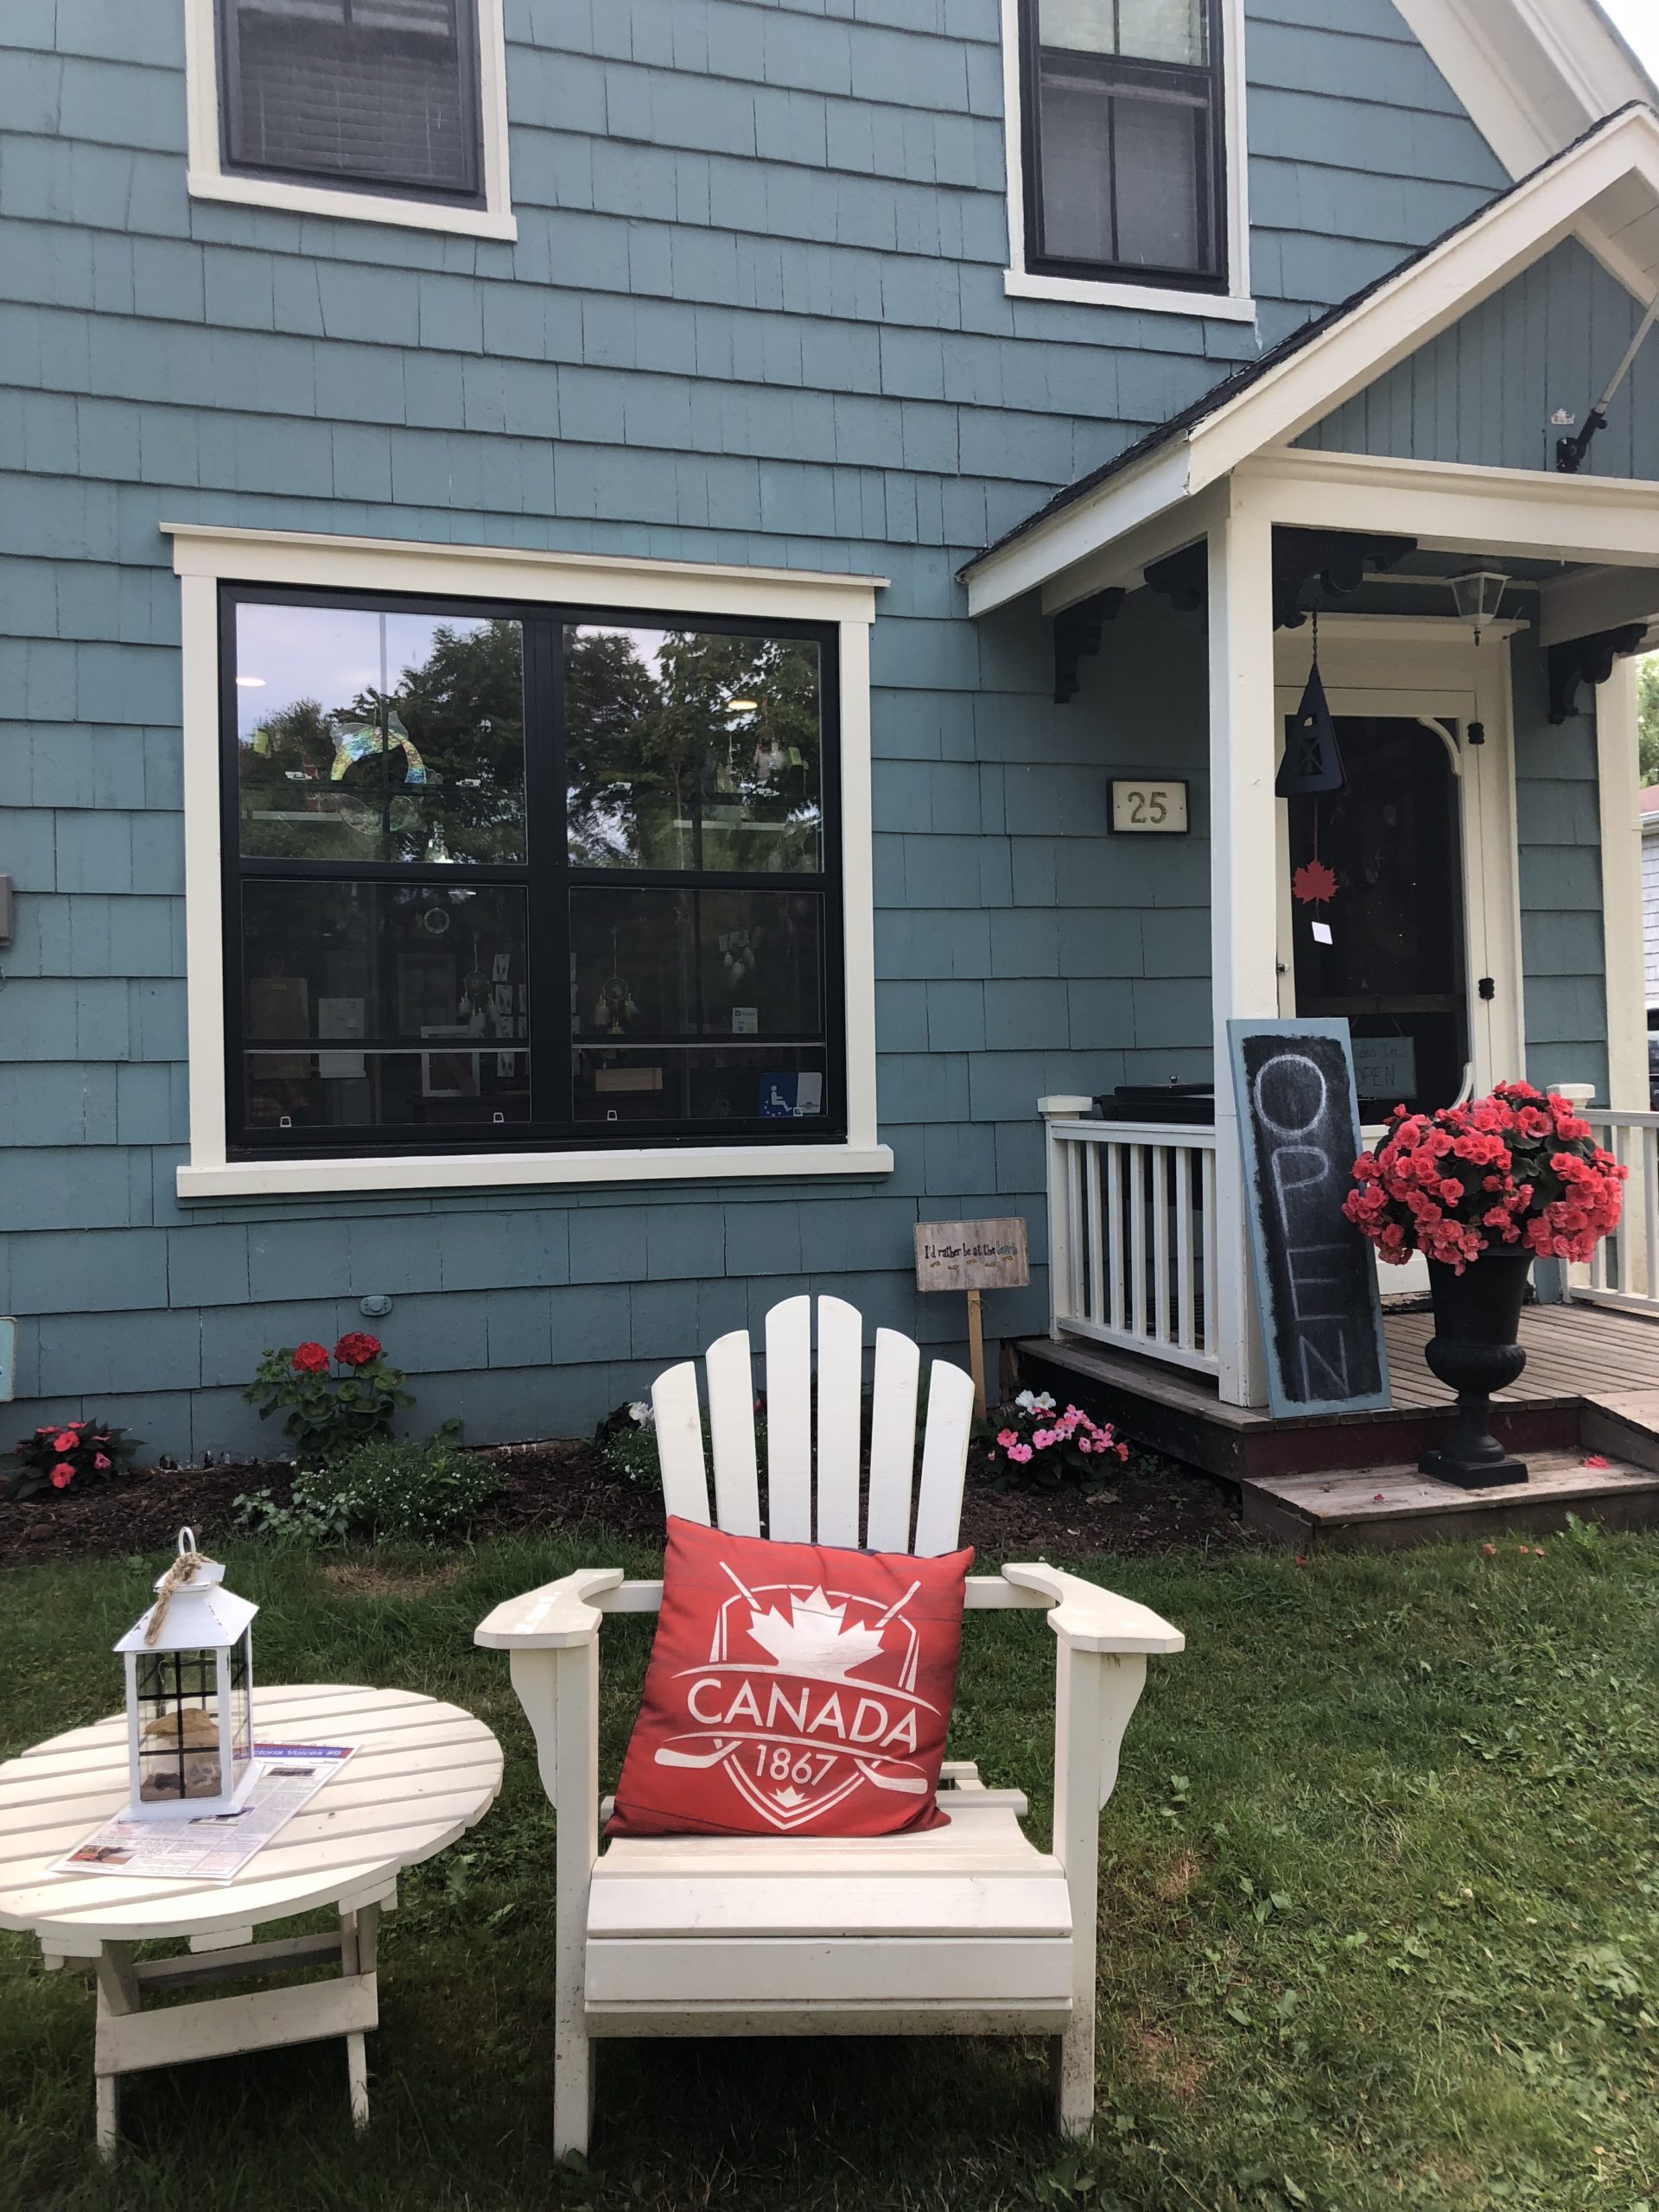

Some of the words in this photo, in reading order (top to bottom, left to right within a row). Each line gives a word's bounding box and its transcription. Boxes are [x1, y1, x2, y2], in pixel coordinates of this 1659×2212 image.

[1127, 791, 1167, 824] 25
[1254, 1053, 1351, 1404] OPEN
[925, 1244, 937, 1259] I'd
[938, 1244, 962, 1258] rather
[963, 1243, 972, 1256] be
[973, 1243, 982, 1256] at
[982, 1243, 995, 1255] the
[687, 1678, 917, 1753] CANADA
[755, 1745, 838, 1786] 1867
